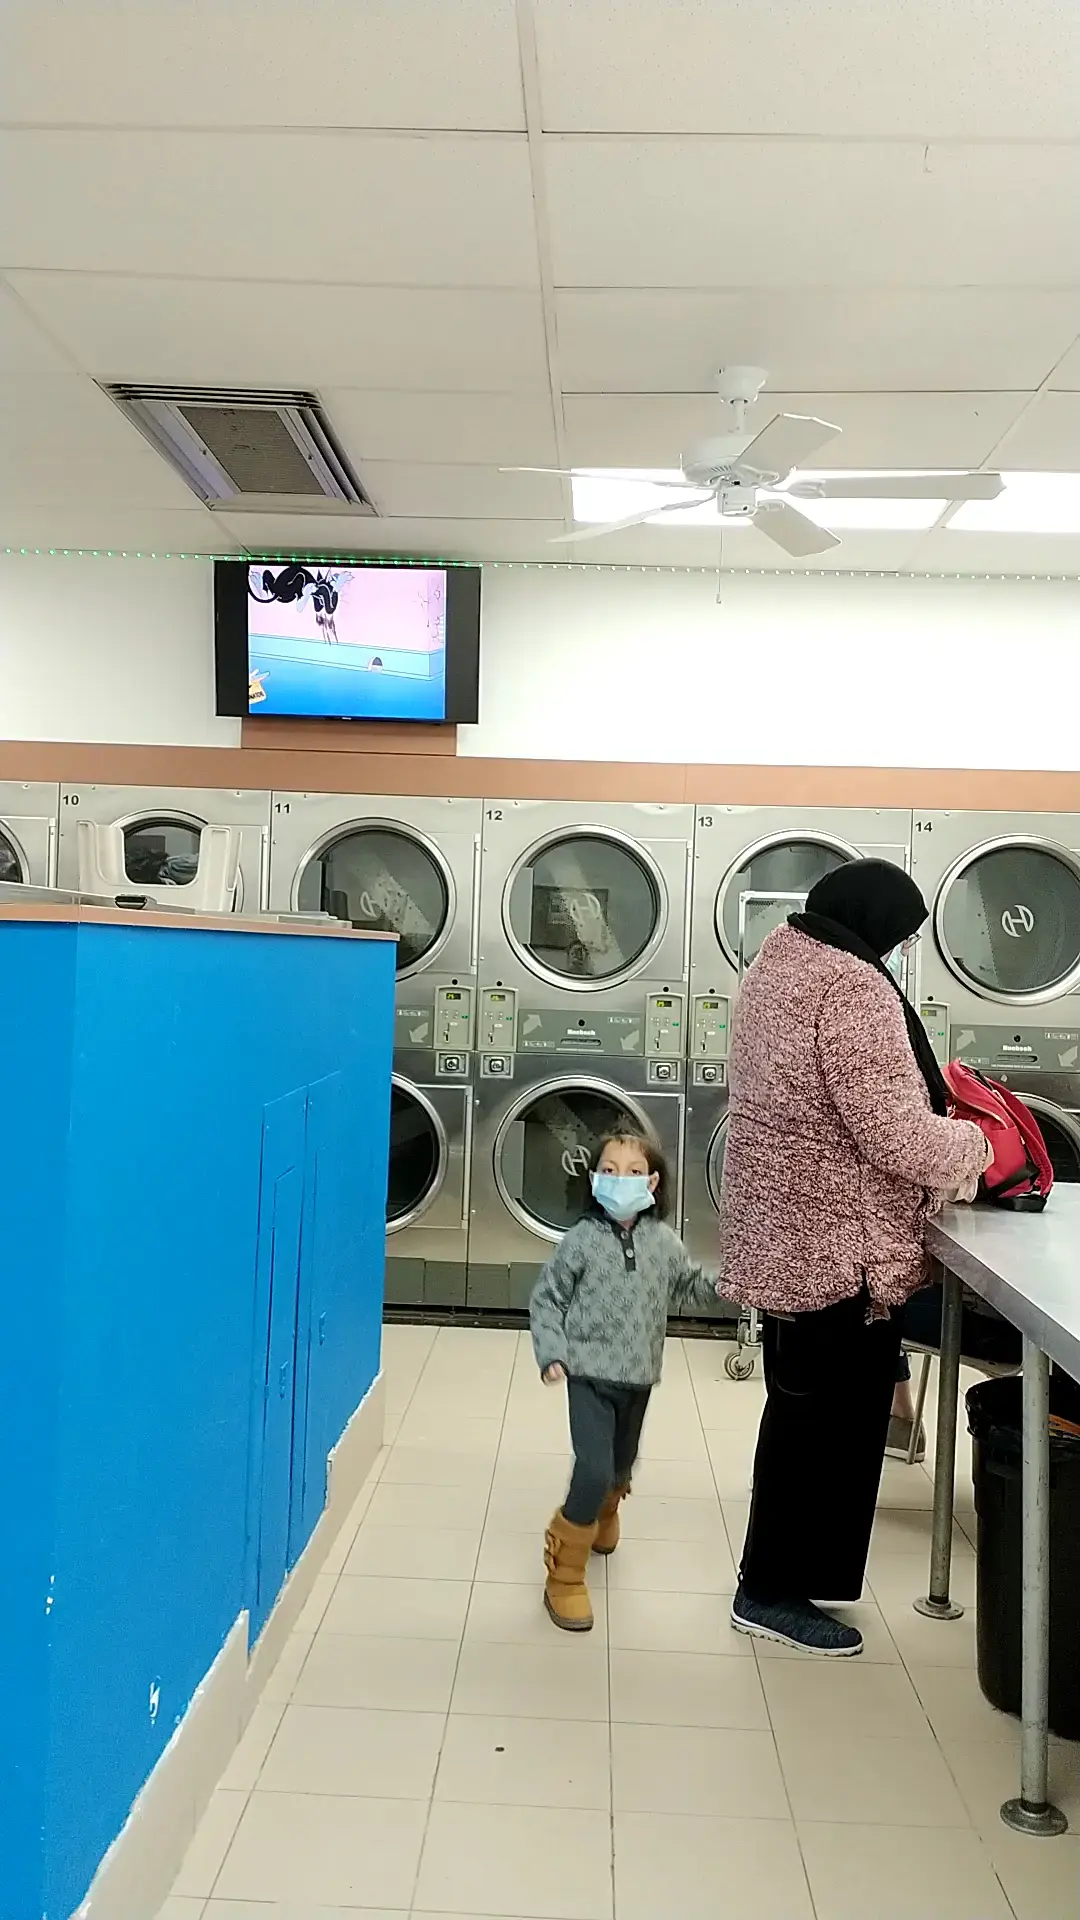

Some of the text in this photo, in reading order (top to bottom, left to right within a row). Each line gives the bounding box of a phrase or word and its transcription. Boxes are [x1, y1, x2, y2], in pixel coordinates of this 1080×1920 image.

[63, 795, 79, 805] 10
[275, 803, 290, 813] 11
[486, 810, 502, 820] 12
[698, 816, 713, 827] 13
[915, 822, 932, 832] 14
